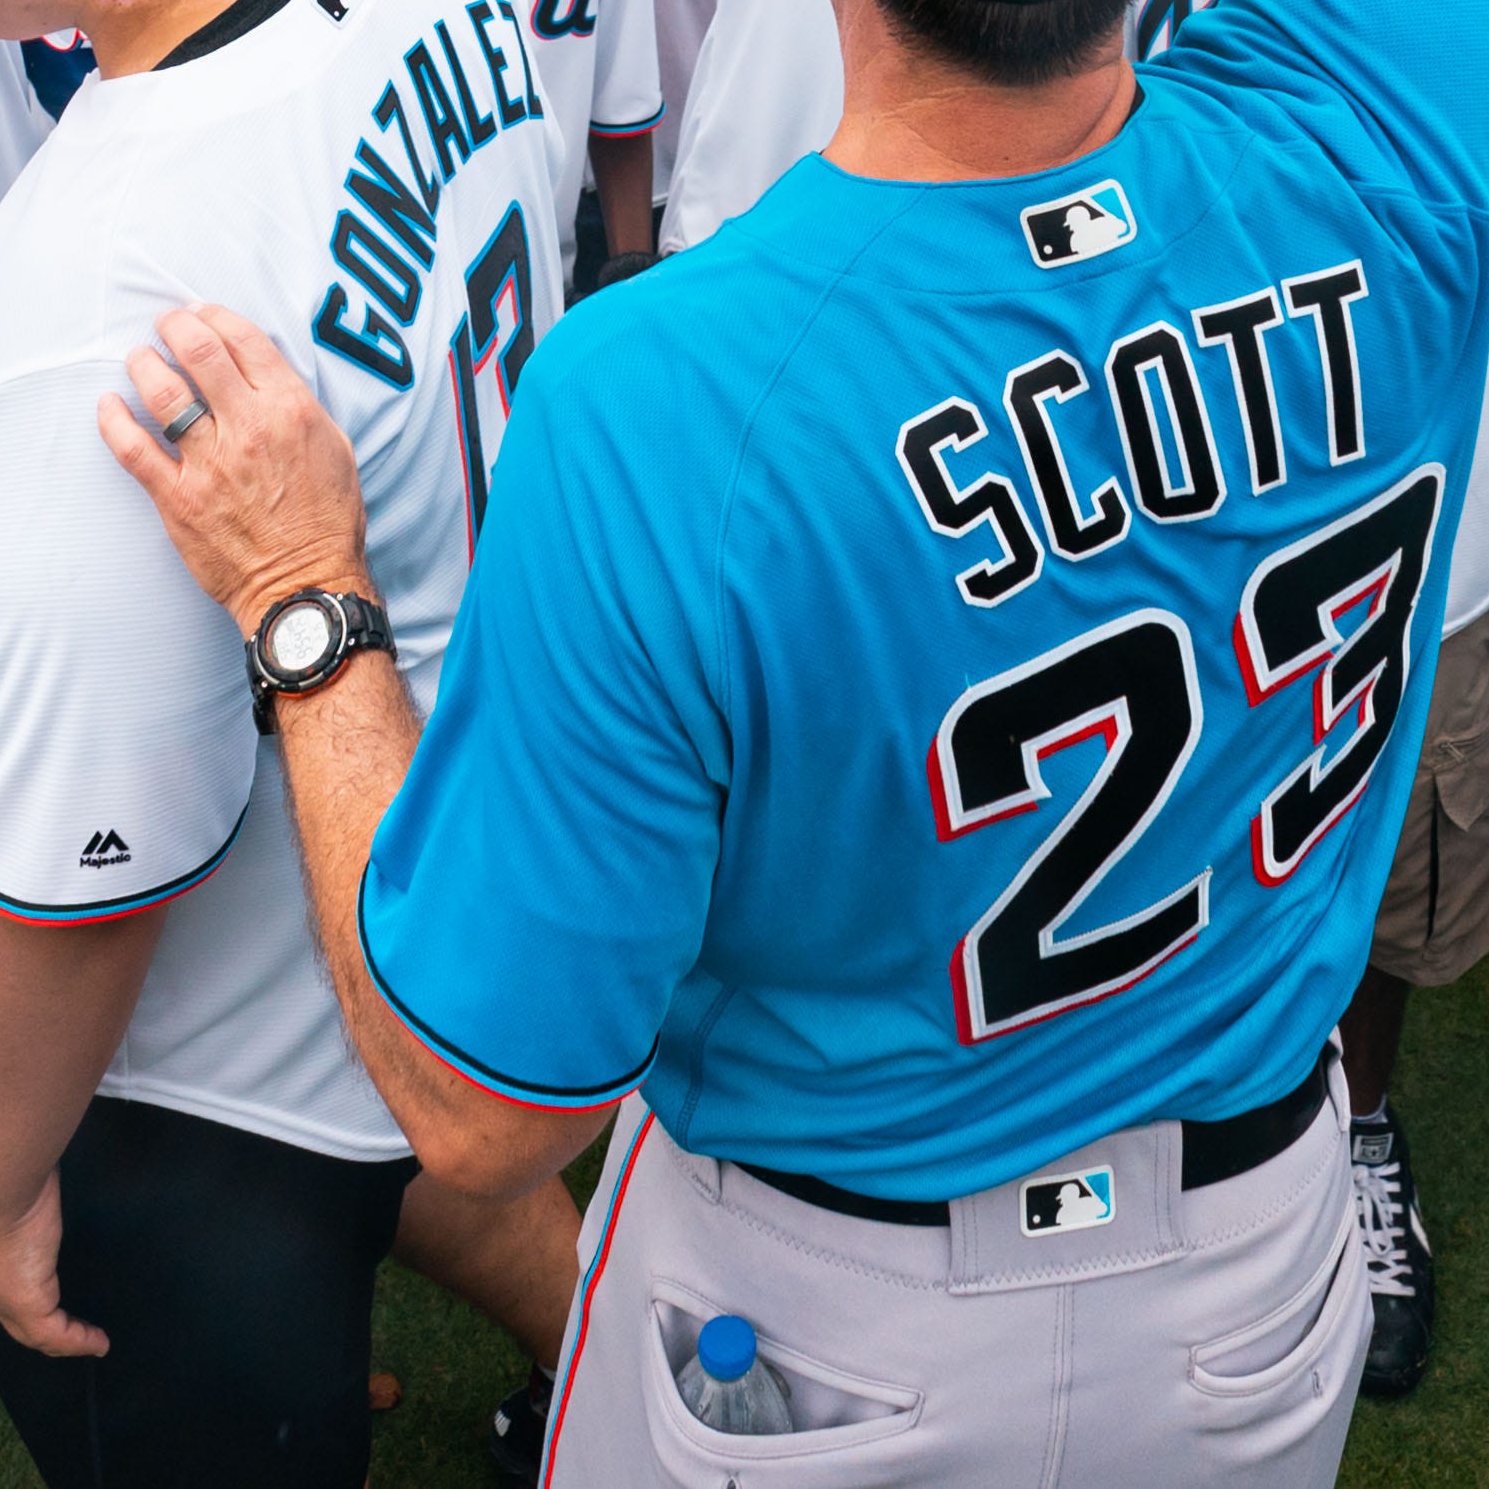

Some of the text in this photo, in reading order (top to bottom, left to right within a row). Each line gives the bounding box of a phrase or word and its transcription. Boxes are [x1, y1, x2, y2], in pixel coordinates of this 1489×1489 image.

[895, 258, 1370, 609] SCOTT
[79, 852, 132, 870] Majestic
[925, 461, 1450, 1048] 23
